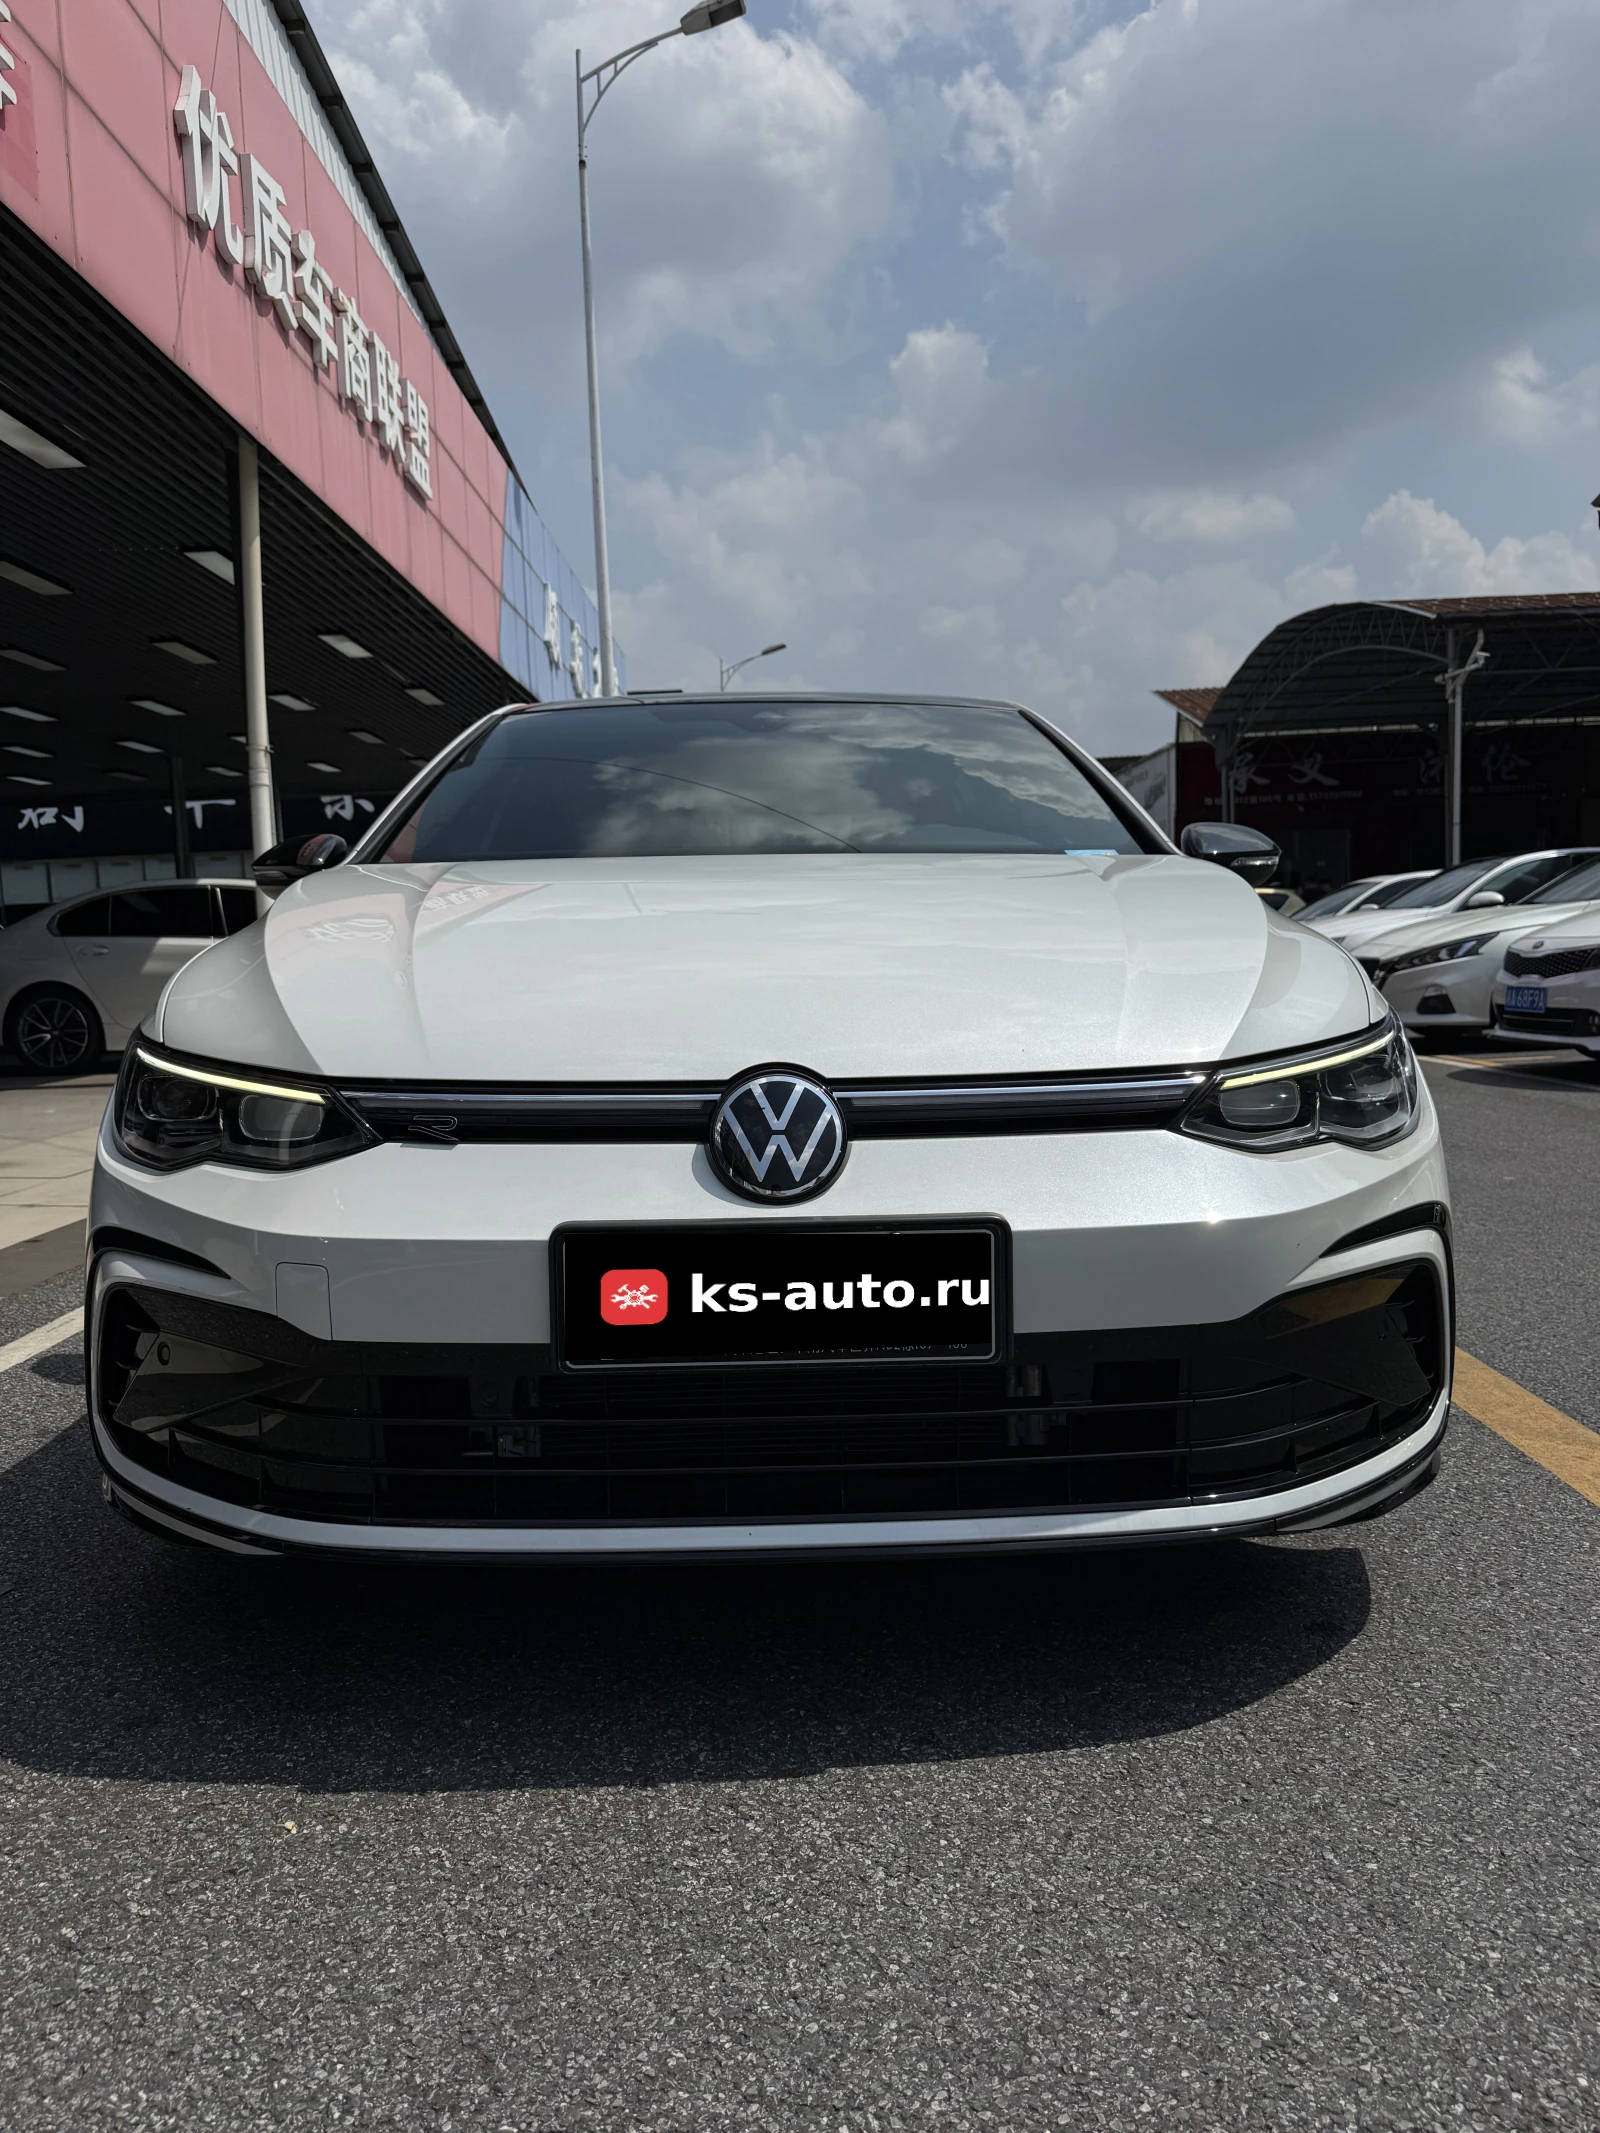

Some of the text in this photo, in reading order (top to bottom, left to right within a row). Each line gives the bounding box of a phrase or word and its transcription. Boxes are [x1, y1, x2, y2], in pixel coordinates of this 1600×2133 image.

[173, 64, 433, 501] 优质车商联盟
[1506, 988, 1545, 1009] A68F9A
